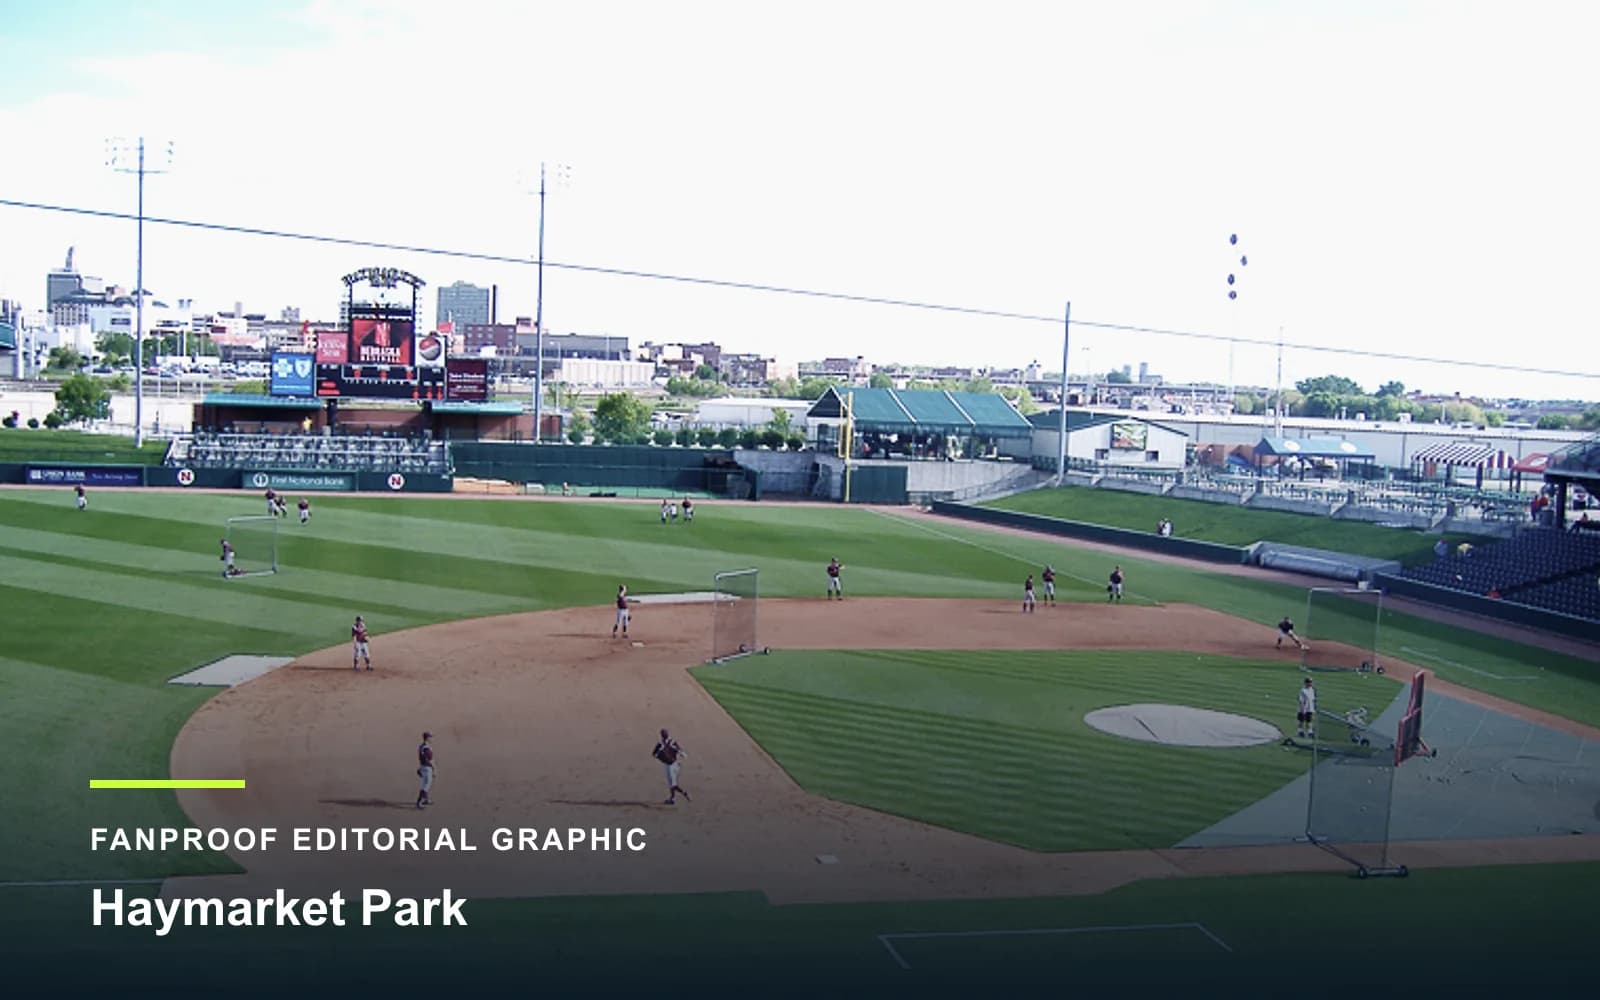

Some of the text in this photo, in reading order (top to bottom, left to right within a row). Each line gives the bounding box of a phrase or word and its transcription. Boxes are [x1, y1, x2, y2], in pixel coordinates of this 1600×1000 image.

[271, 476, 344, 486] First National Bank
